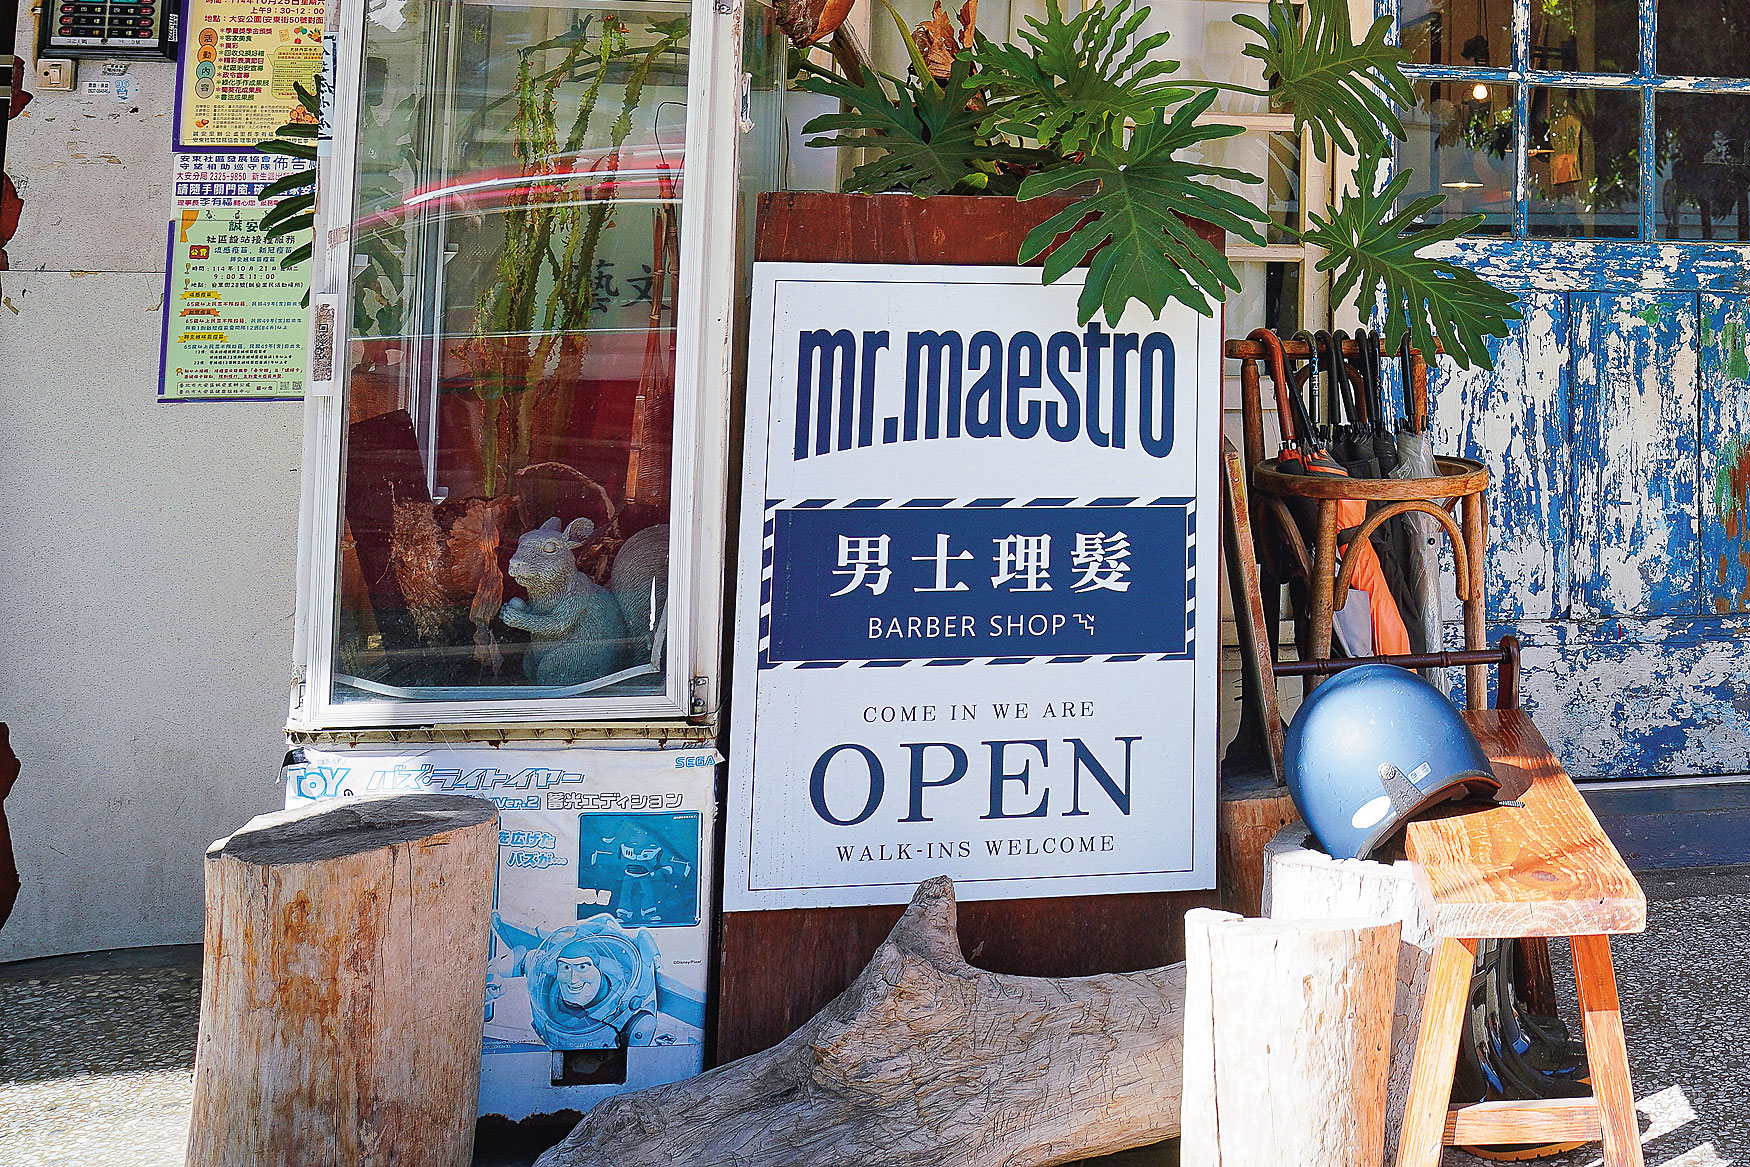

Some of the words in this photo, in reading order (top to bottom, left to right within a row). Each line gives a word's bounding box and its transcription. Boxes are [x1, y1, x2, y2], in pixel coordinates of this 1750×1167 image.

[176, 172, 208, 181] 大安分局
[209, 173, 247, 181] 2325-9850
[793, 321, 1176, 463] mr.maestro
[829, 530, 1133, 598] 男士理髮
[868, 615, 977, 639] BARBER
[989, 614, 1067, 638] SHOP
[862, 705, 937, 724] COME
[949, 704, 978, 722] IN
[992, 702, 1029, 721] WE
[1041, 701, 1096, 719] ARE
[674, 754, 716, 769] SEGA
[287, 766, 351, 800] TOY
[809, 735, 1143, 827] OPEN
[546, 791, 684, 810] 蓄光エディション
[836, 841, 971, 863] WALK-INS
[985, 835, 1116, 857] WELCOME
